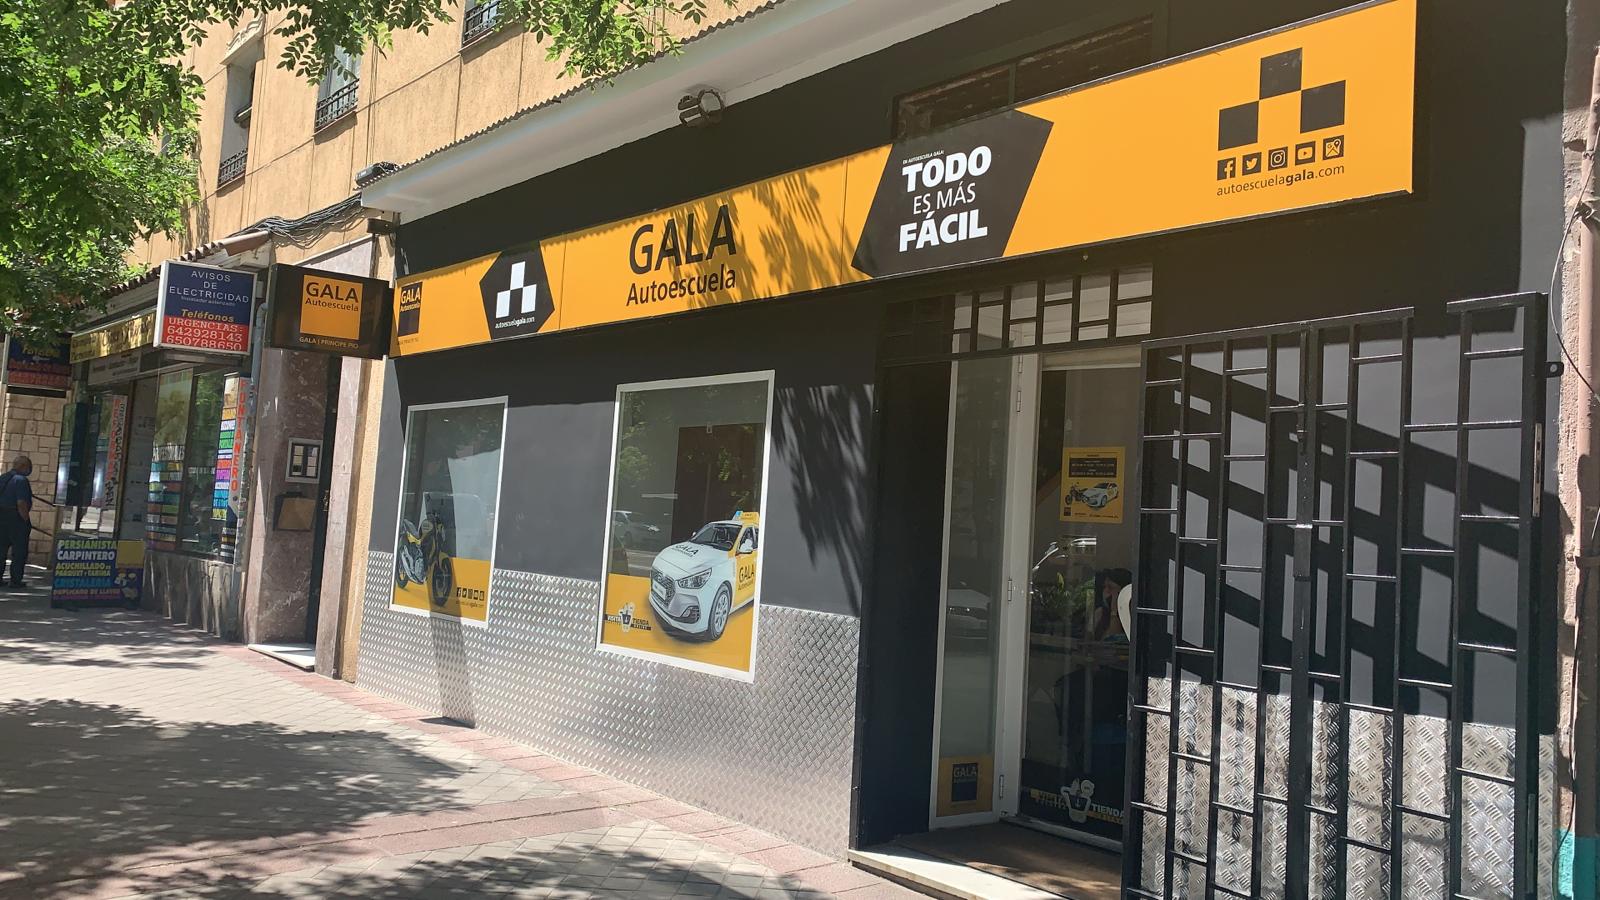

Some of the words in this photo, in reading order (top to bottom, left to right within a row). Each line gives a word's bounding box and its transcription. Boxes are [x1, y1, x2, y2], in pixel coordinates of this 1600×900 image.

[902, 145, 992, 192] TODO
[1216, 165, 1345, 196] autoescuelagala.com
[913, 193, 932, 215] ES
[936, 181, 976, 210] MÁS
[899, 210, 988, 252] FÁCIL
[629, 204, 737, 275] GALA
[191, 270, 231, 282] AVISOS
[203, 281, 217, 290] DE
[306, 282, 359, 303] GALA
[626, 263, 736, 307] Autoescuela
[169, 286, 249, 303] ELECTRICIDAD
[401, 287, 421, 304] GALA
[305, 297, 359, 312] Autoescuela
[181, 309, 234, 322] Teléfonos
[495, 316, 535, 329] autoescuelagala.com
[167, 325, 242, 342] 642928143
[299, 336, 317, 344] GALA
[166, 335, 242, 350] 650788650
[57, 540, 117, 550] PERSIANISTA
[674, 544, 700, 556] GALA
[57, 550, 115, 561] CARPINTERO
[56, 562, 105, 570] ACUCHILLADO
[738, 564, 755, 583] GALA
[953, 766, 977, 778] GALA
